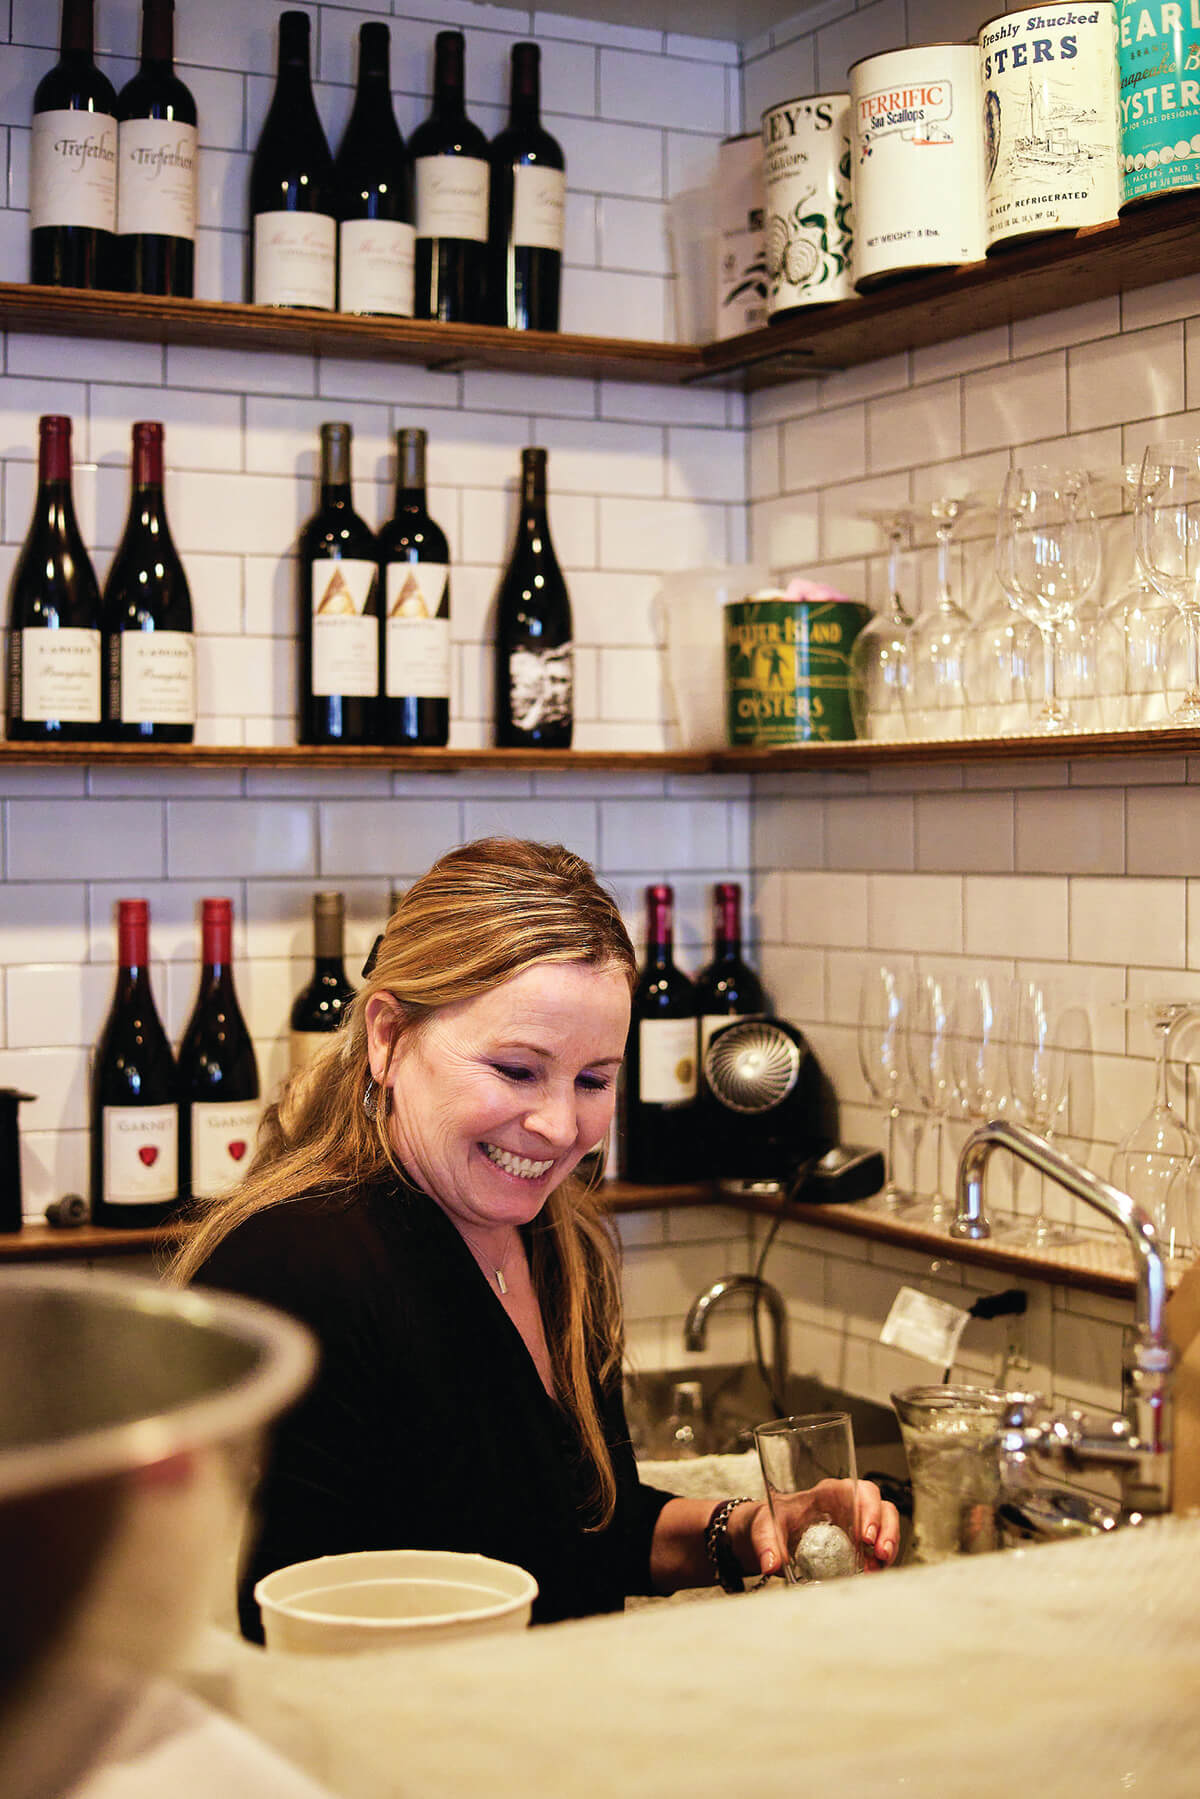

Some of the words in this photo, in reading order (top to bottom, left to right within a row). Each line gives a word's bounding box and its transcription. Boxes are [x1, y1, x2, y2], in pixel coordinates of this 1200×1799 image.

[982, 24, 1020, 48] Freshly
[1026, 11, 1099, 31] Shucked
[985, 35, 1077, 80] STERS
[860, 86, 943, 119] TERRIFIC
[871, 115, 884, 129] Sea
[887, 109, 924, 125] Scallops
[1143, 116, 1157, 125] SIZE
[1169, 164, 1188, 174] AND
[1015, 191, 1088, 208] REFRIGERATED
